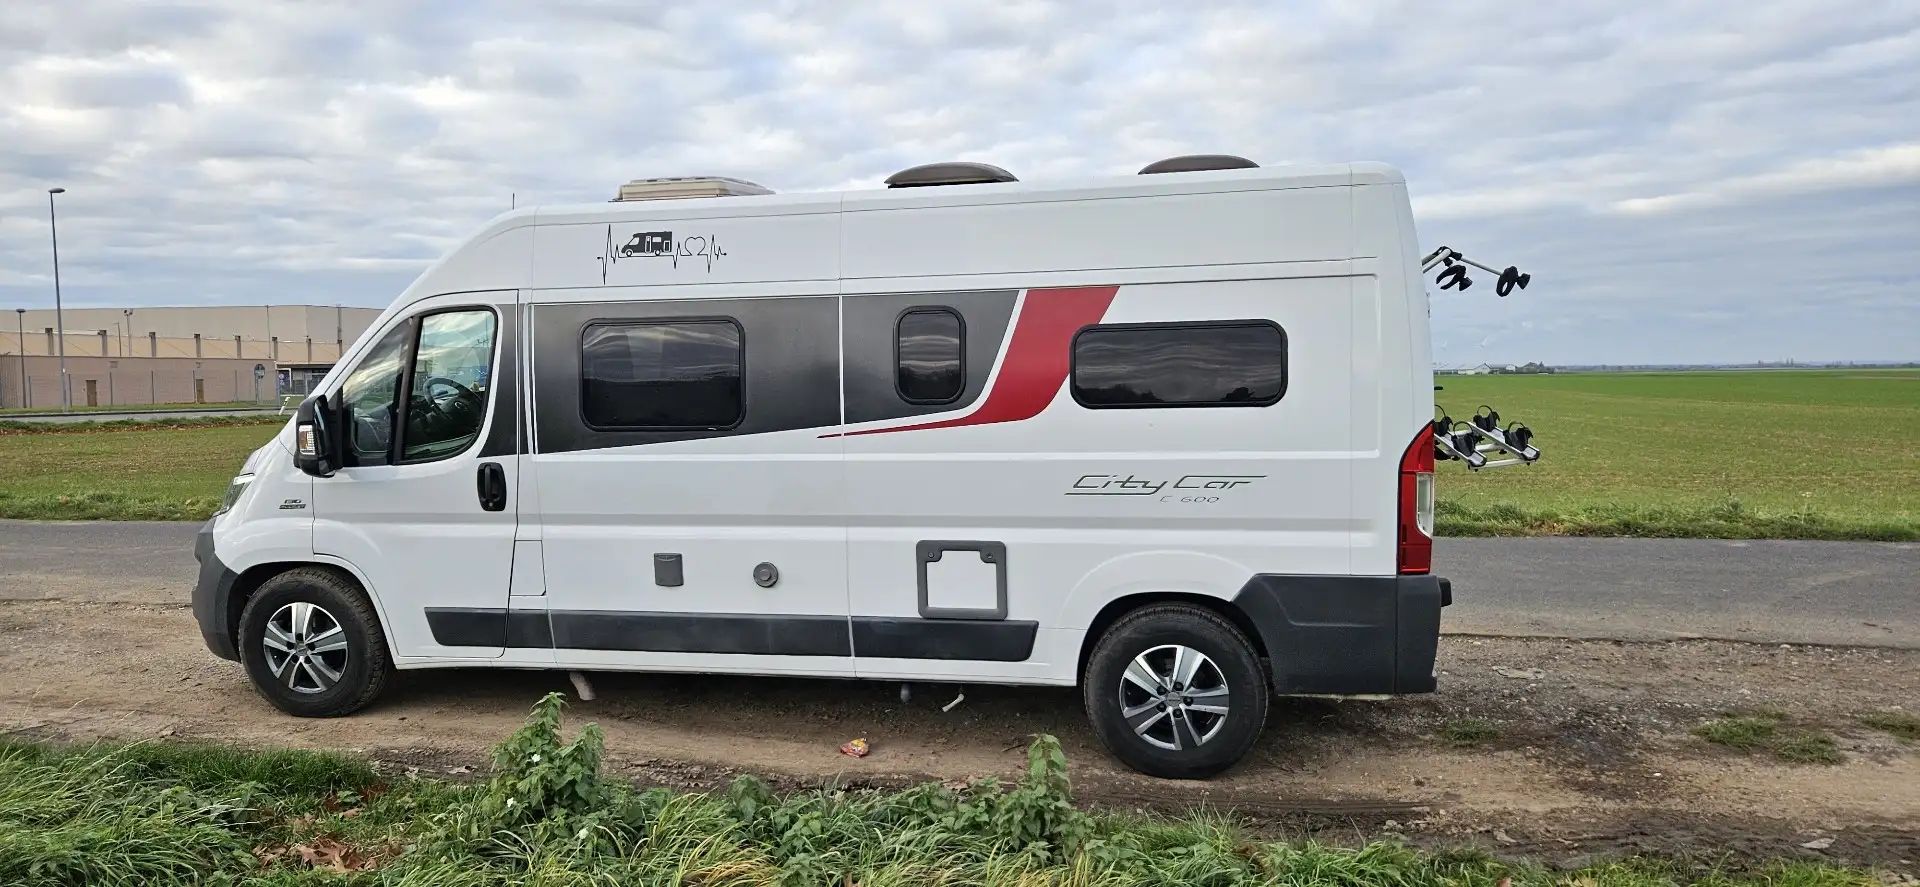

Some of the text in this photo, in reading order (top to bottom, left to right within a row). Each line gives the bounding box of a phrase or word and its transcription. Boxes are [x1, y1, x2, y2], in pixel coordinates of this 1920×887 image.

[1064, 474, 1268, 496] City Car
[1180, 495, 1220, 504] 600
